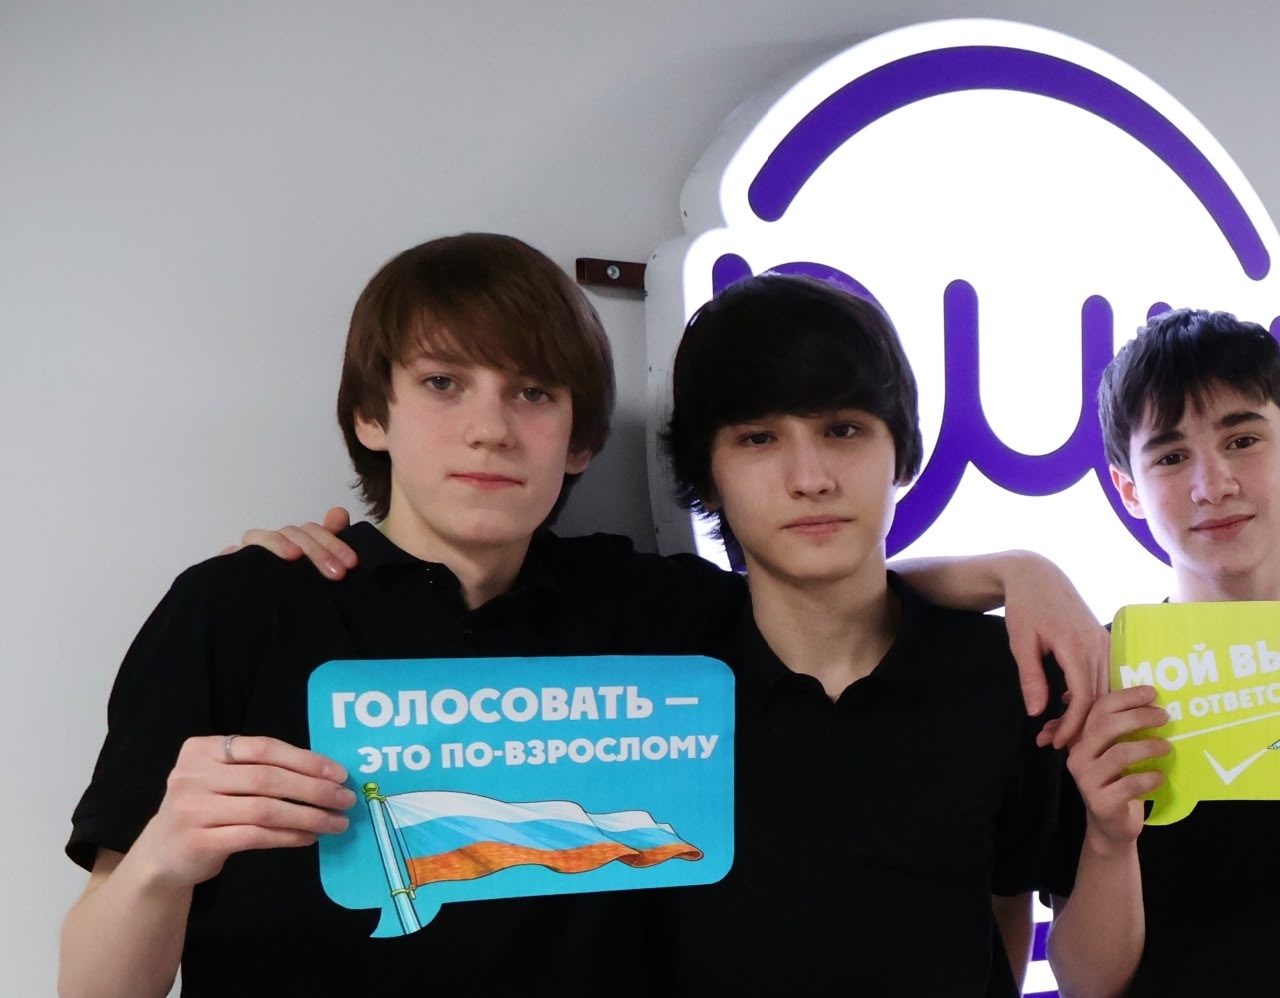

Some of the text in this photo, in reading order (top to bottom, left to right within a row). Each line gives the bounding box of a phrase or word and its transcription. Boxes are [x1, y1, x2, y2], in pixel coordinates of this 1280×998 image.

[1119, 642, 1219, 691] МОЙ
[331, 685, 654, 729] ГОЛОСОВАТЬ
[358, 735, 719, 774] ЭТО ПО-ВЗРОСЛОМУ
